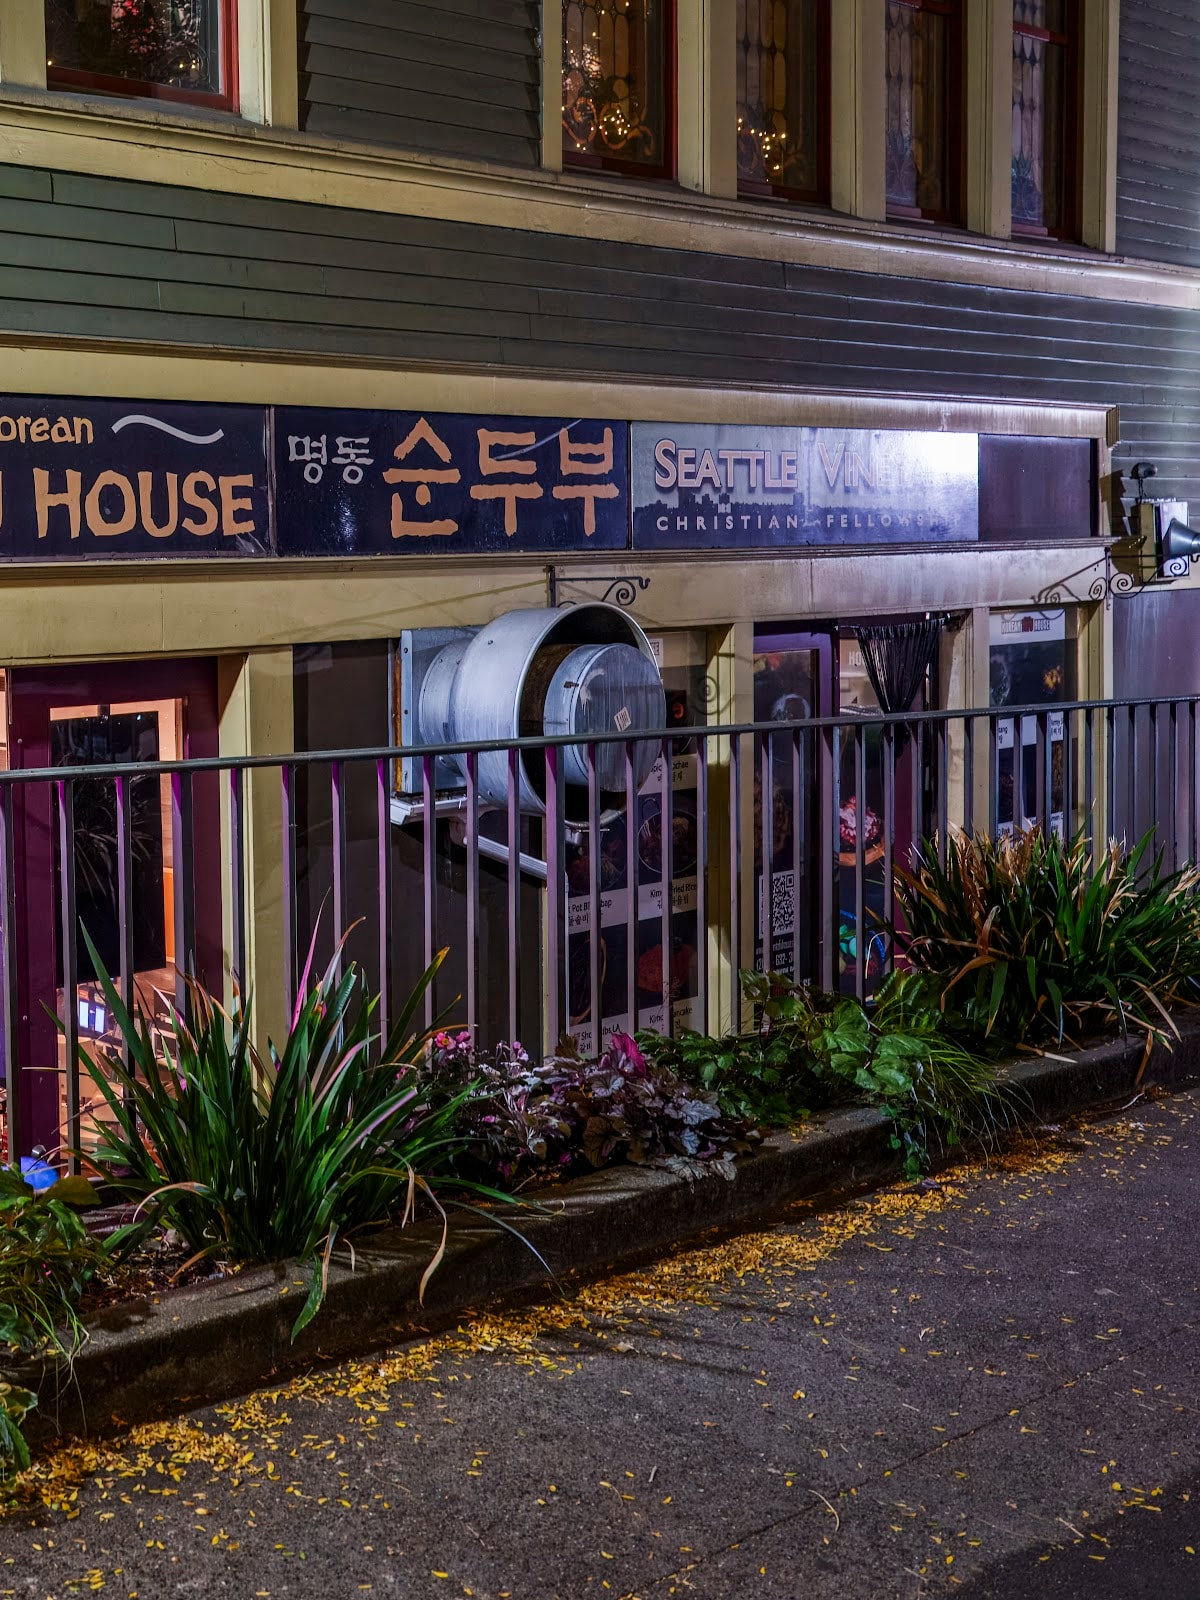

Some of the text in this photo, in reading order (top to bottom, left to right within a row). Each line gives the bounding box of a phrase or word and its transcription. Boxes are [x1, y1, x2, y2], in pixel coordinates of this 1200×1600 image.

[287, 416, 619, 539] 명동 순두부
[654, 438, 799, 493] SEATTLE
[33, 467, 256, 538] HOUSE
[656, 514, 799, 532] CHRISTIAN
